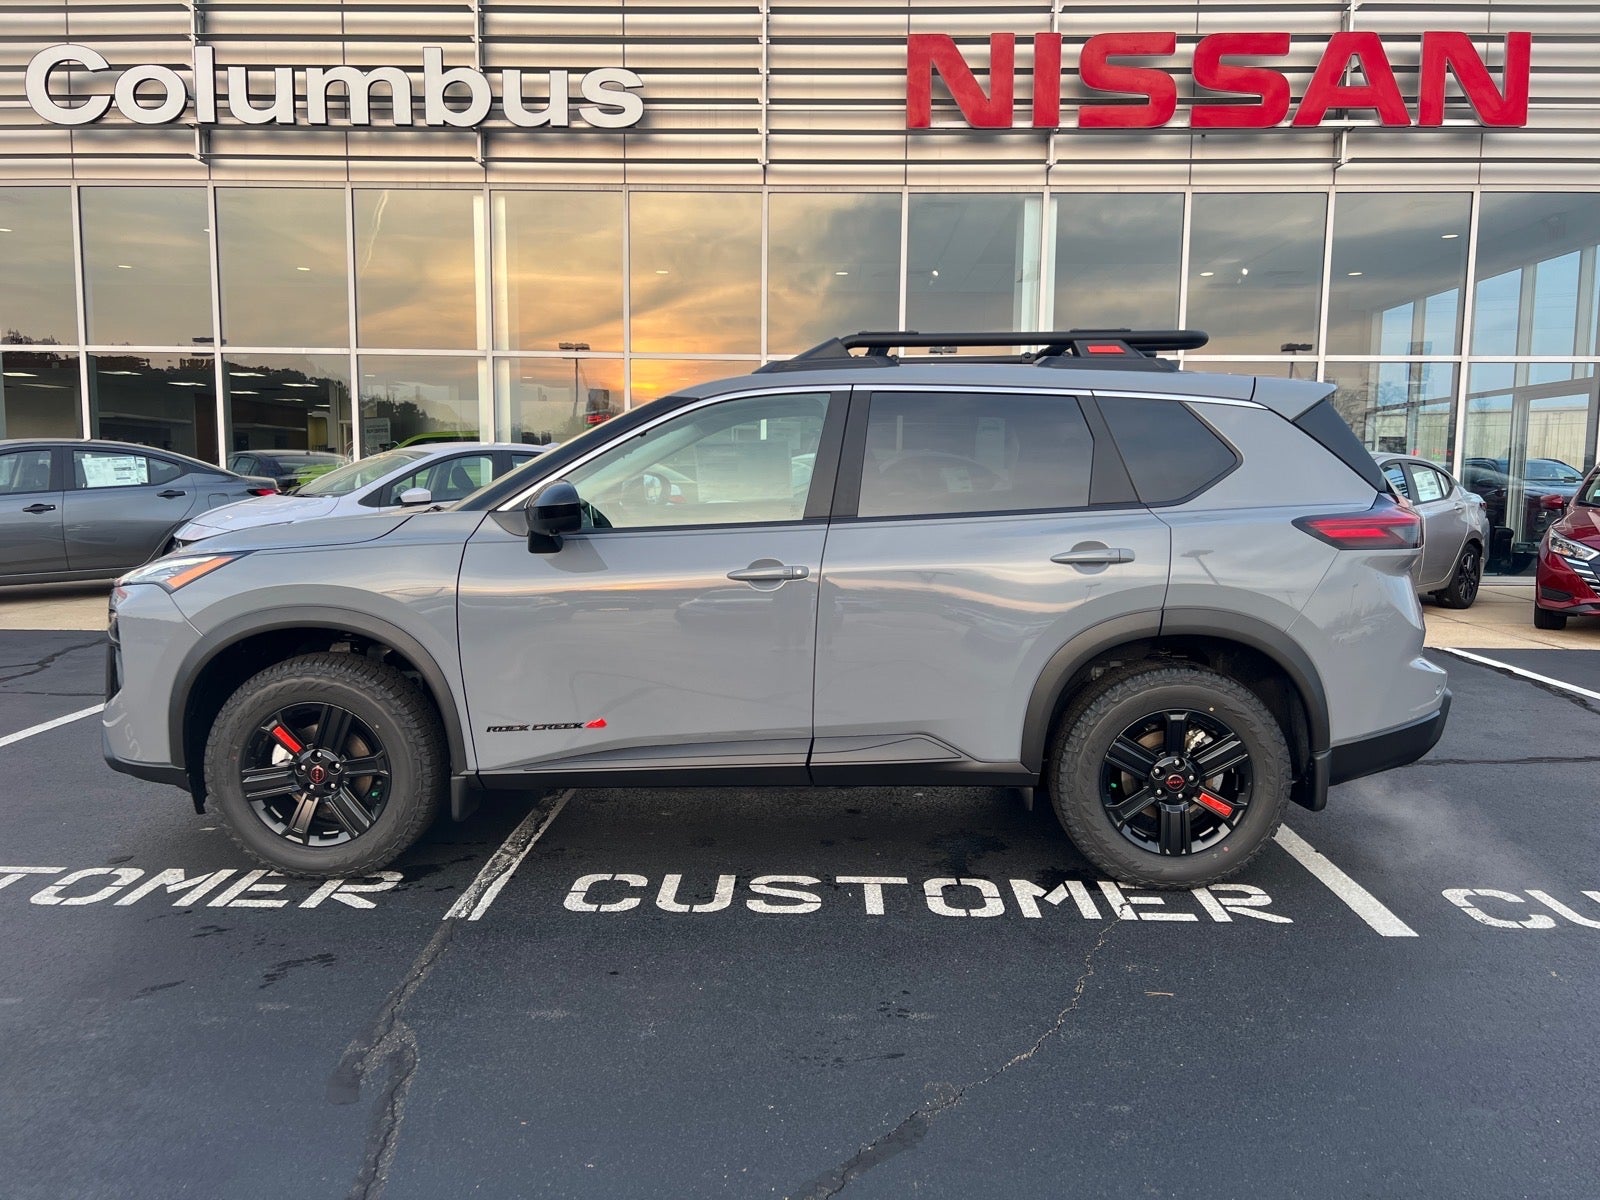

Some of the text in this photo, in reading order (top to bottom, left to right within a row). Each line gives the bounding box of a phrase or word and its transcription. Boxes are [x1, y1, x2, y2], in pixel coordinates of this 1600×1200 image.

[25, 43, 645, 129] Columbus
[906, 31, 1532, 129] NISSAN
[486, 722, 584, 732] ROCK CREEK
[563, 873, 1294, 924] CUSTOMER
